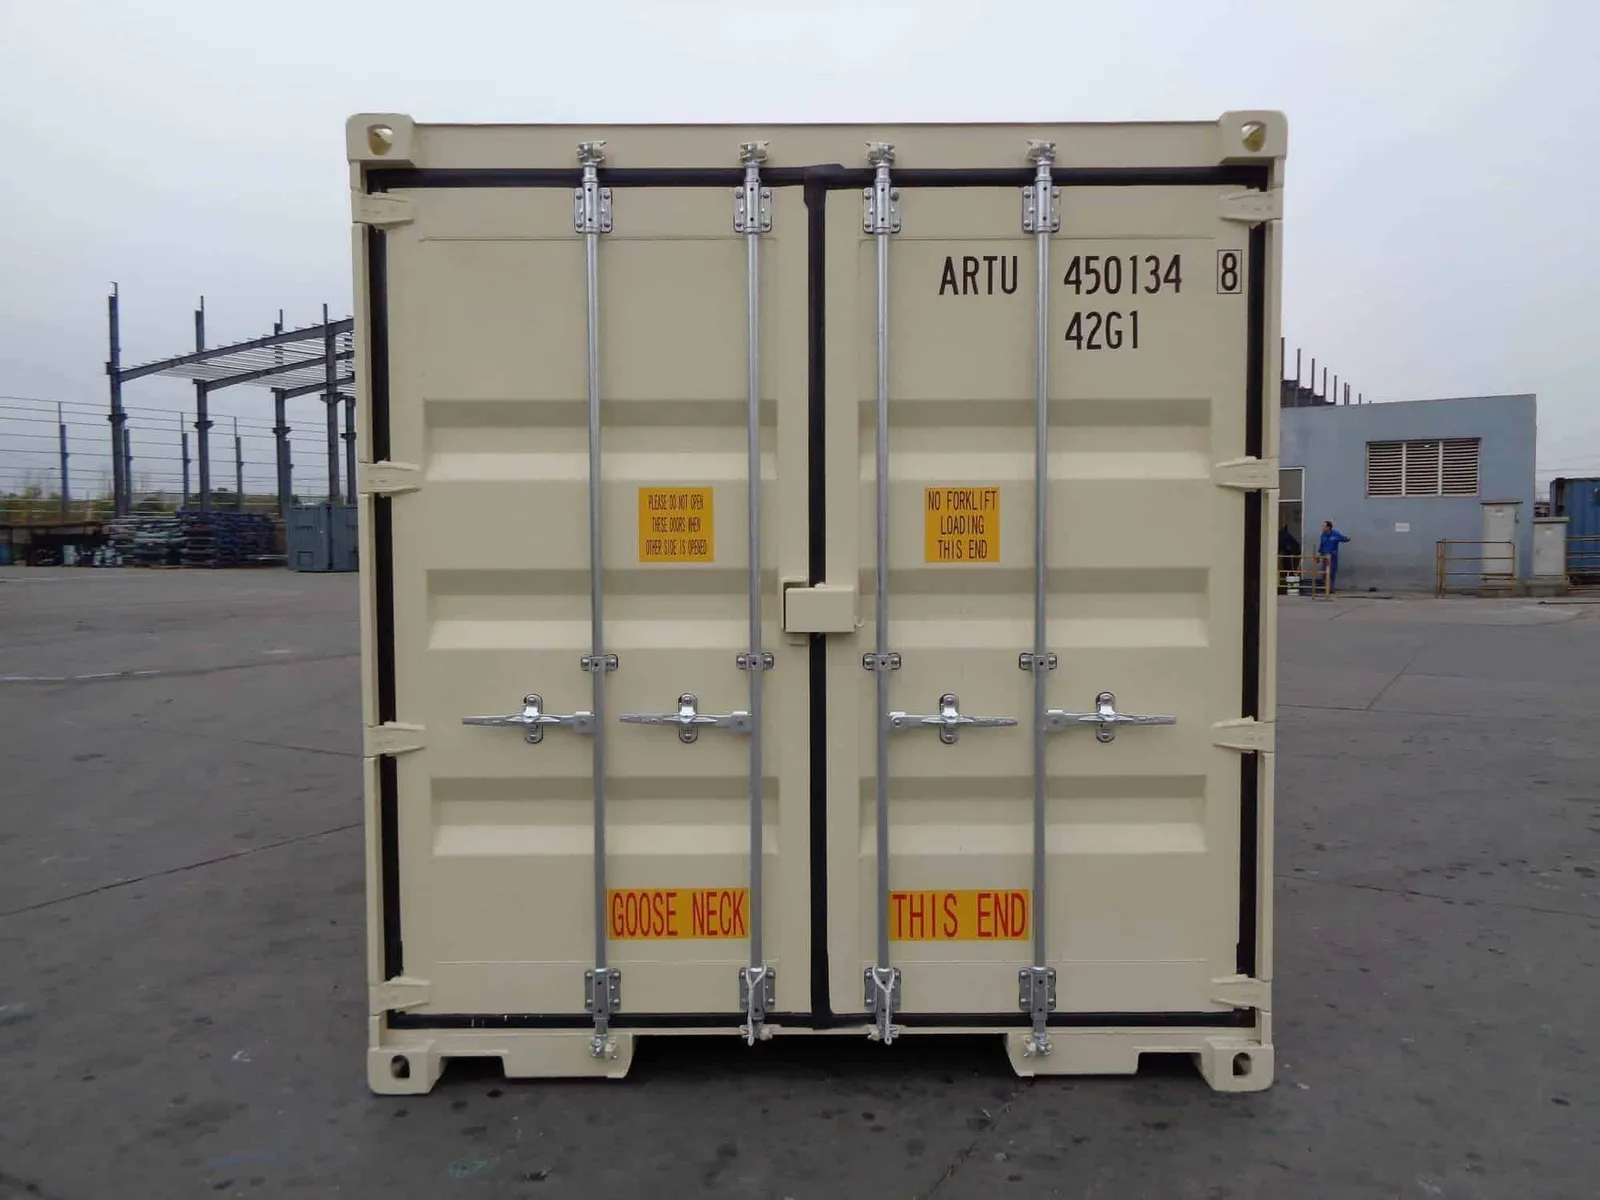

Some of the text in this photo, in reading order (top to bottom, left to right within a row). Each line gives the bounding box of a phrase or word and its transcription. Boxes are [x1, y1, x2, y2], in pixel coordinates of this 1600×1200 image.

[939, 253, 1238, 295] ARTU 450134 8
[1065, 310, 1139, 350] 42G1
[648, 494, 704, 510] PLEASE DO NOT OPEN
[928, 491, 997, 511] NO FORKLIFT
[652, 516, 701, 533] THESE DOORS WHEN
[940, 515, 985, 535] LOADING
[646, 539, 707, 555] OTHER SIDE IS OPENED
[938, 539, 988, 559] THIS END
[612, 891, 745, 937] GOOSE NECK
[892, 893, 1027, 938] THIS END
